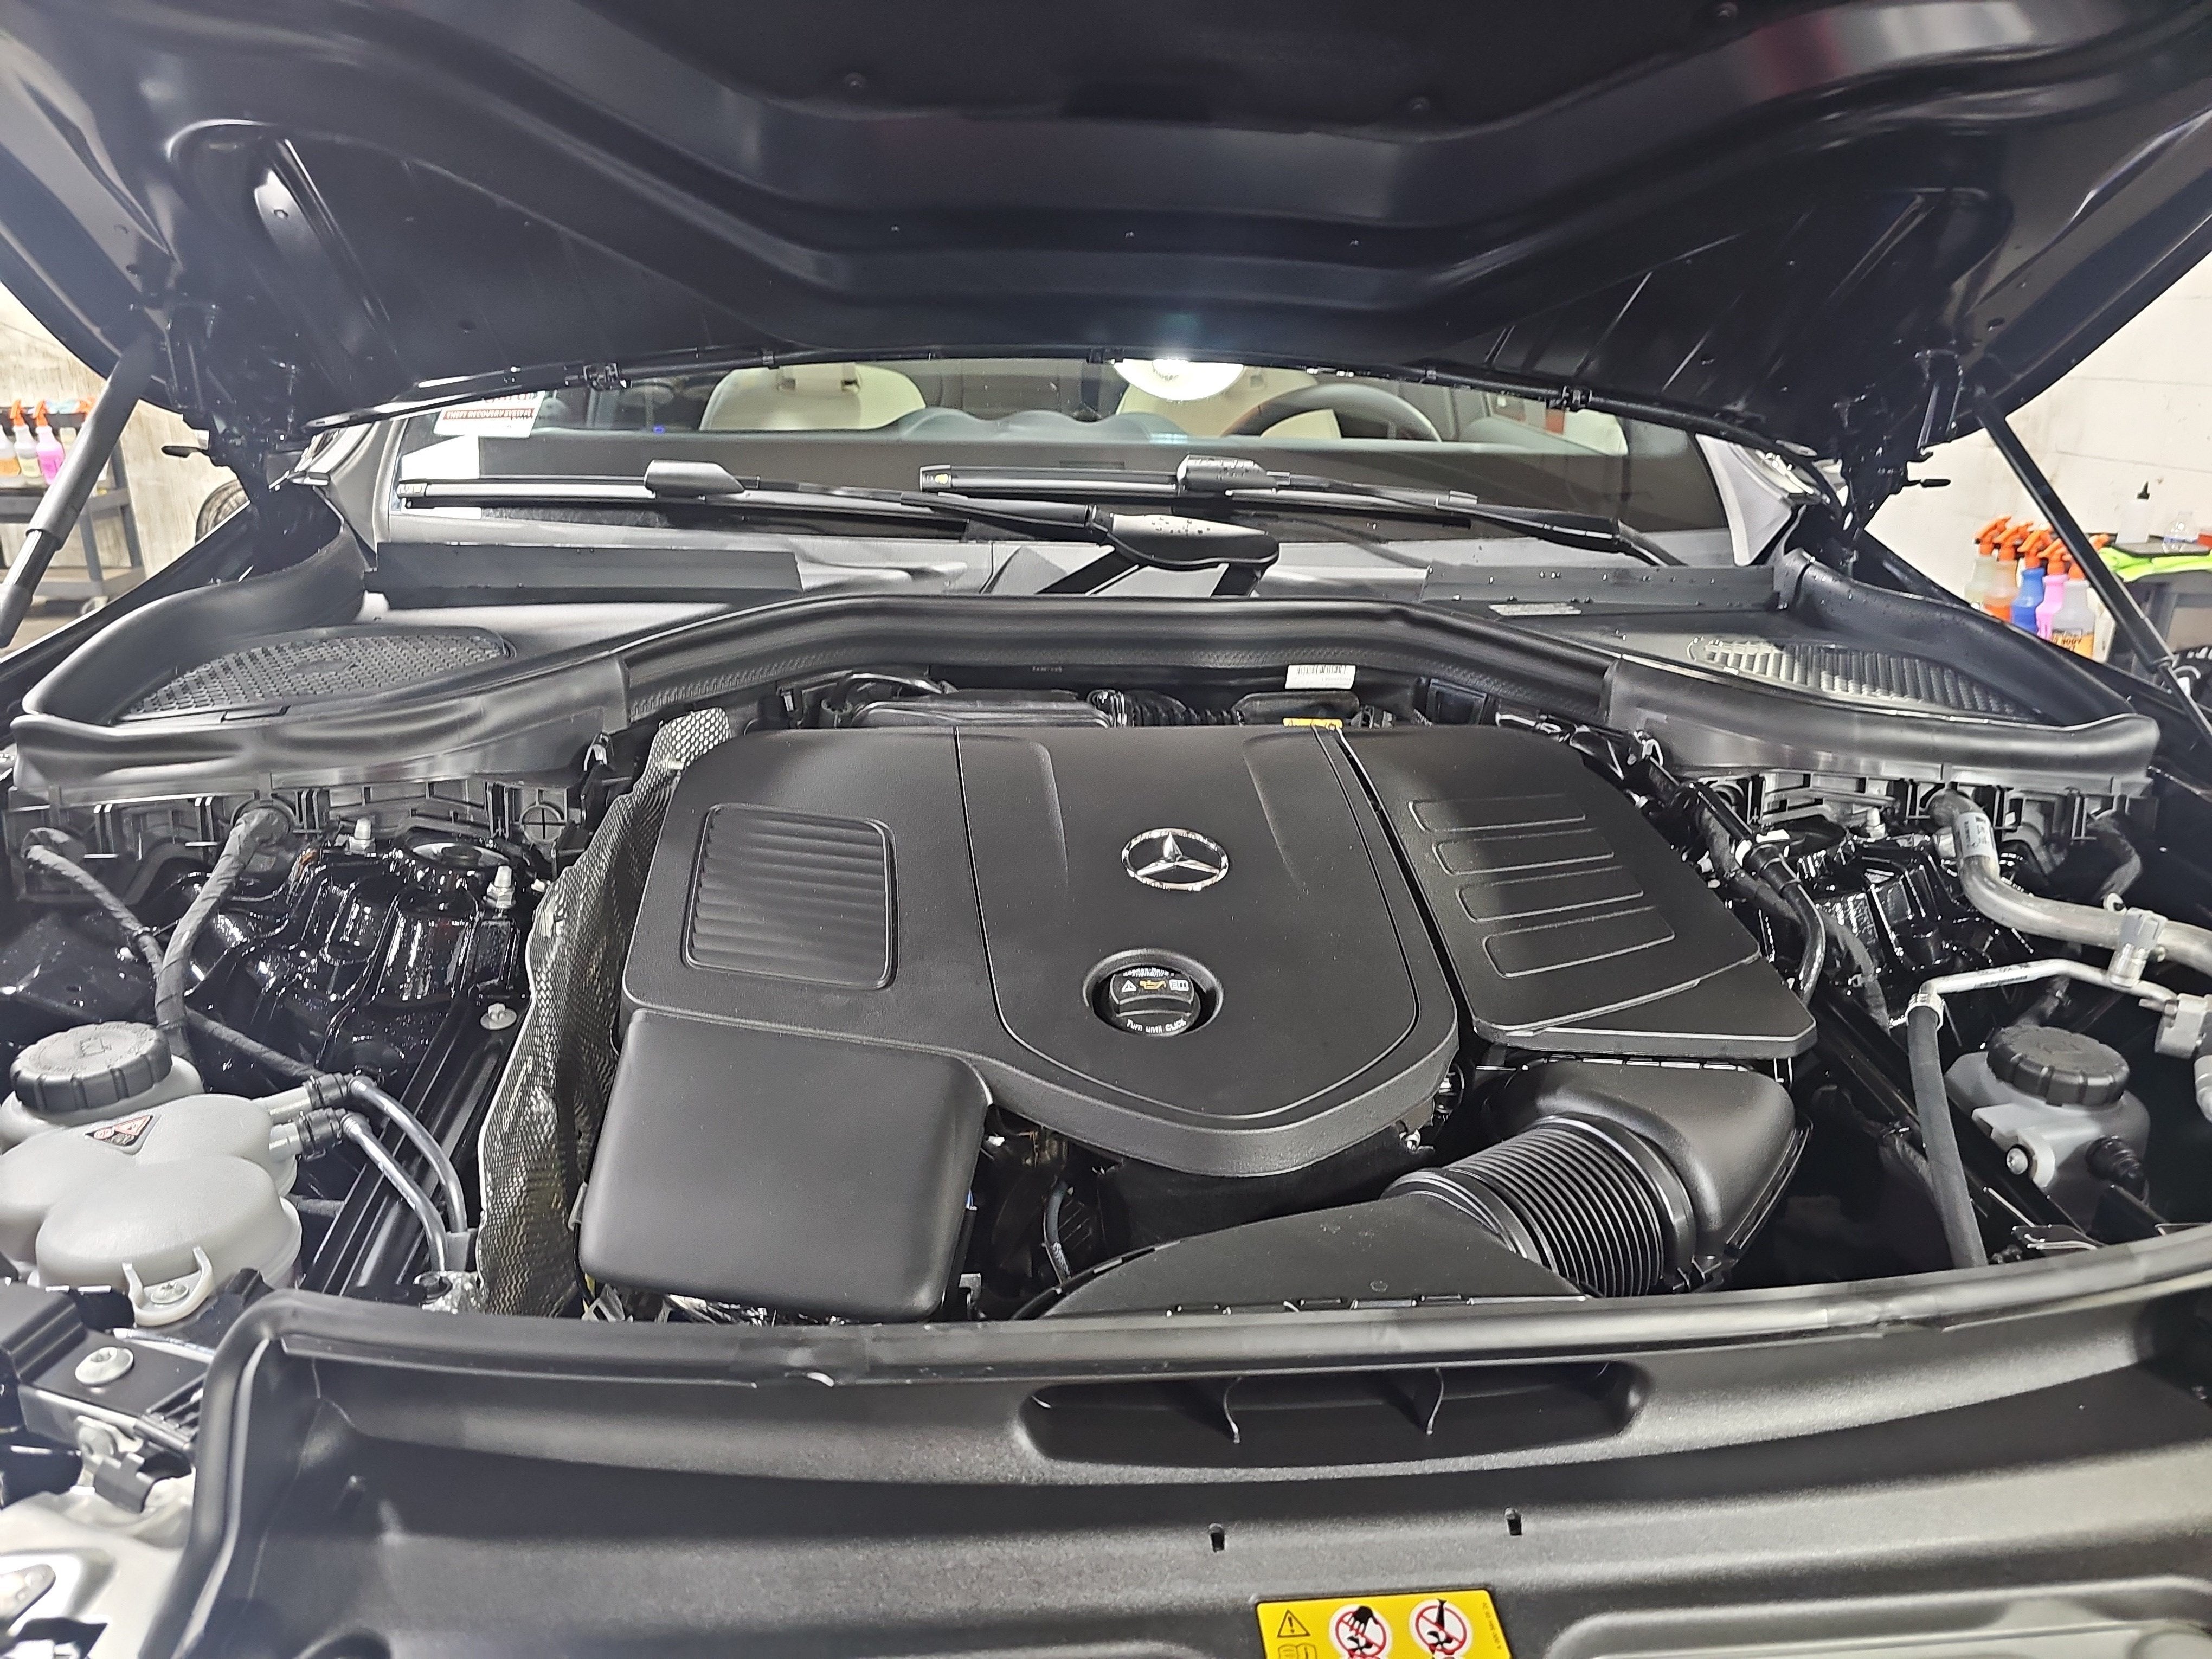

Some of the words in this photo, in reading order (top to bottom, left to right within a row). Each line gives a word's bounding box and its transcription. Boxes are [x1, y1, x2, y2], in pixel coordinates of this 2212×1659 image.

[467, 409, 504, 418] RECOVERY
[1127, 1019, 1143, 1032] Turn
[1146, 1025, 1162, 1033] until
[1165, 1018, 1187, 1032] CLICK
